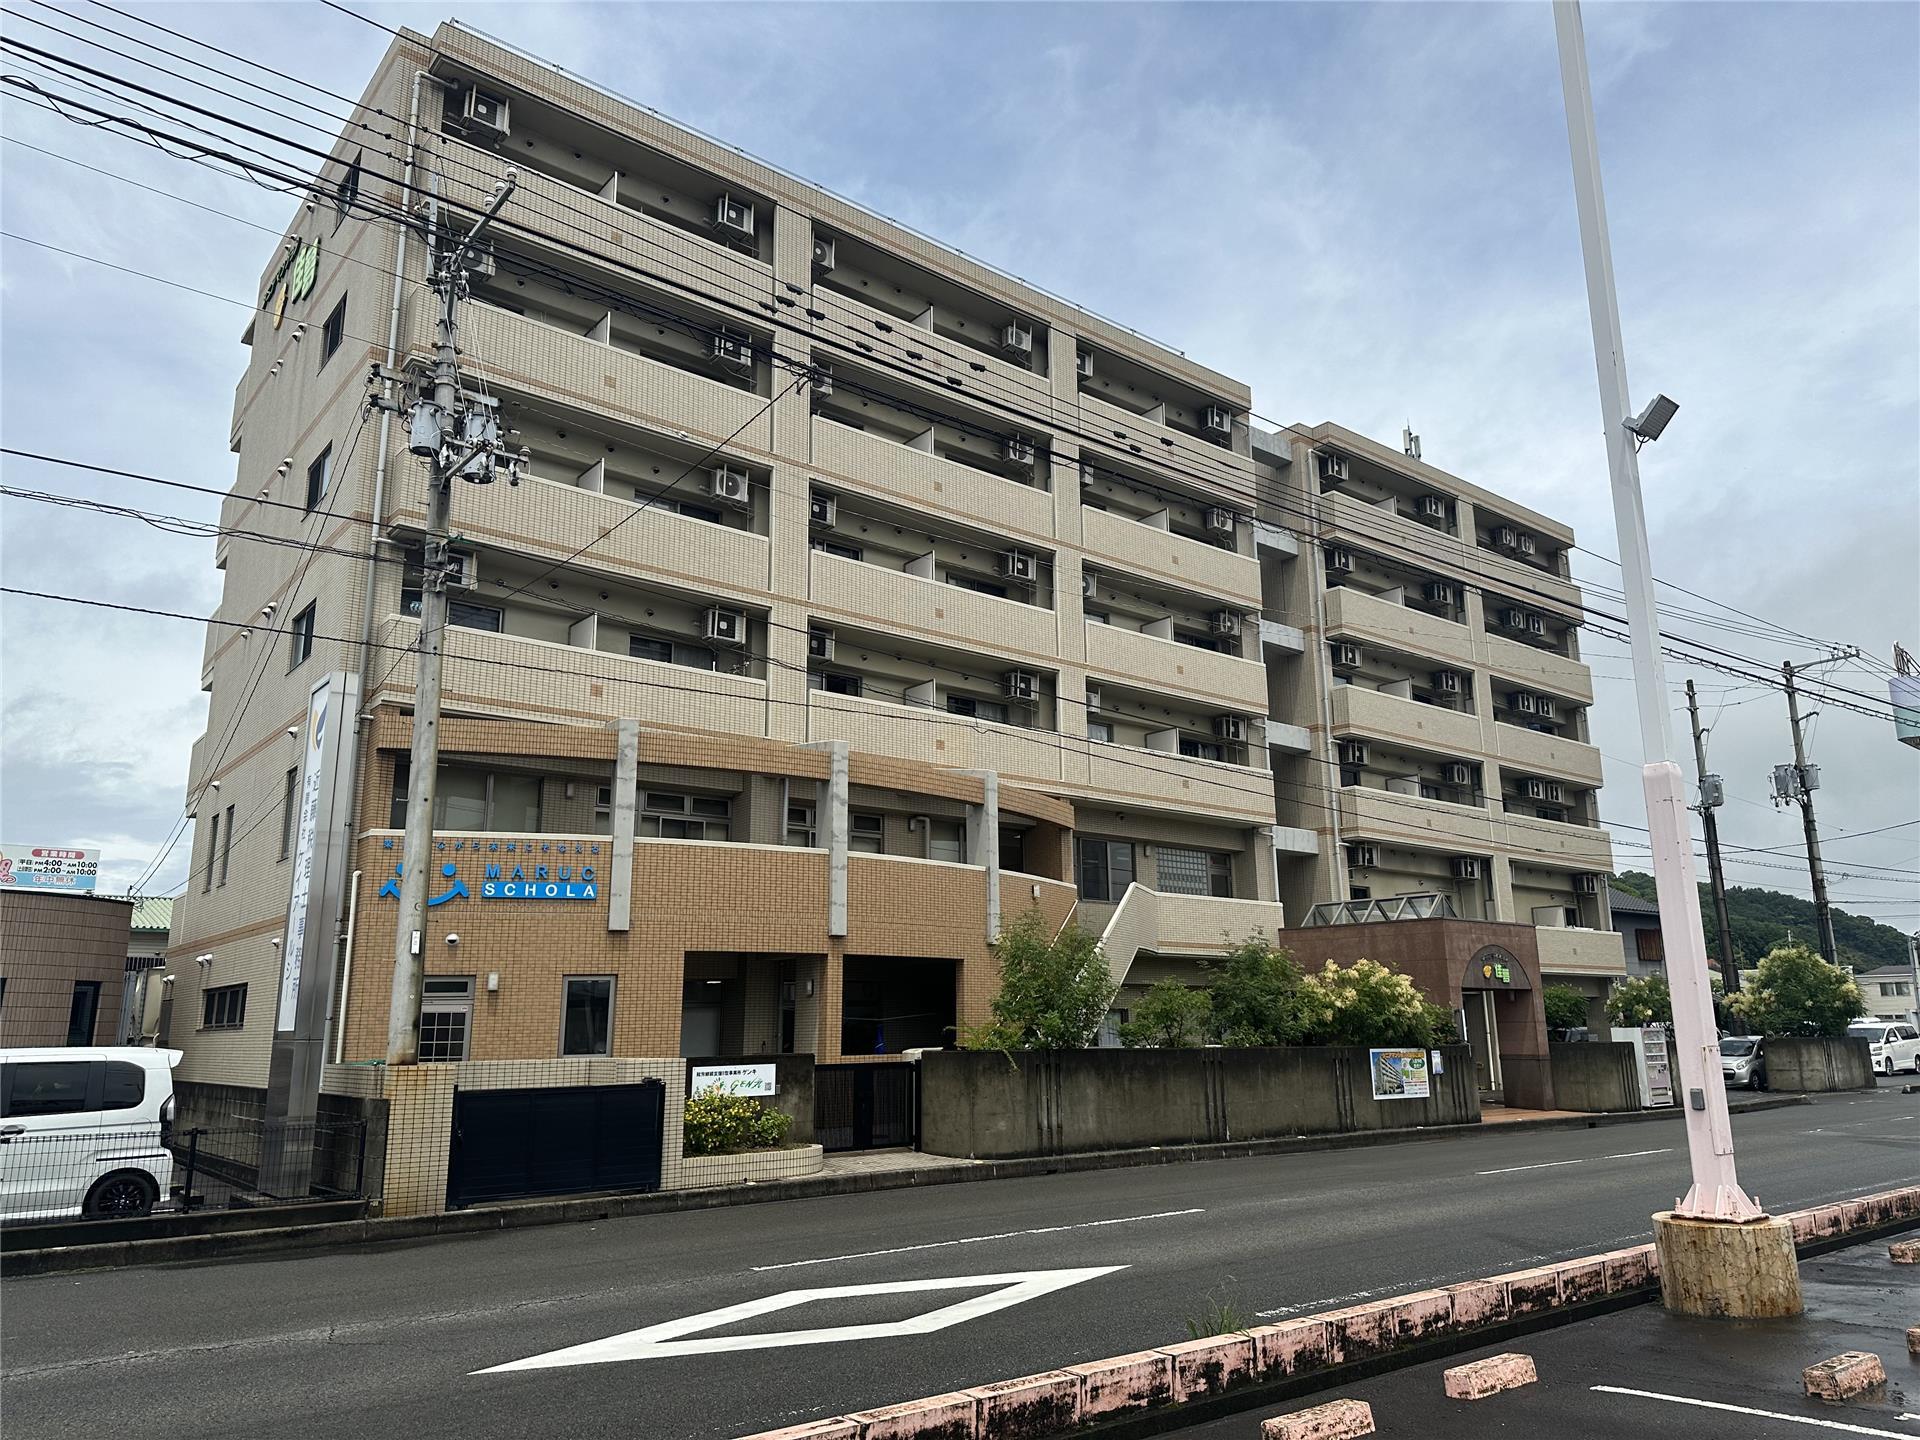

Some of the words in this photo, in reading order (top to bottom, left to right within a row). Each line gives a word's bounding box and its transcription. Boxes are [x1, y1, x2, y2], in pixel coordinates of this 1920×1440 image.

[384, 838, 600, 854] 楽ながら未来にそなえる
[41, 850, 76, 859] 営業時間
[485, 863, 596, 881] MARUC
[33, 875, 76, 885] 年中無休
[484, 883, 595, 897] SCHOLA
